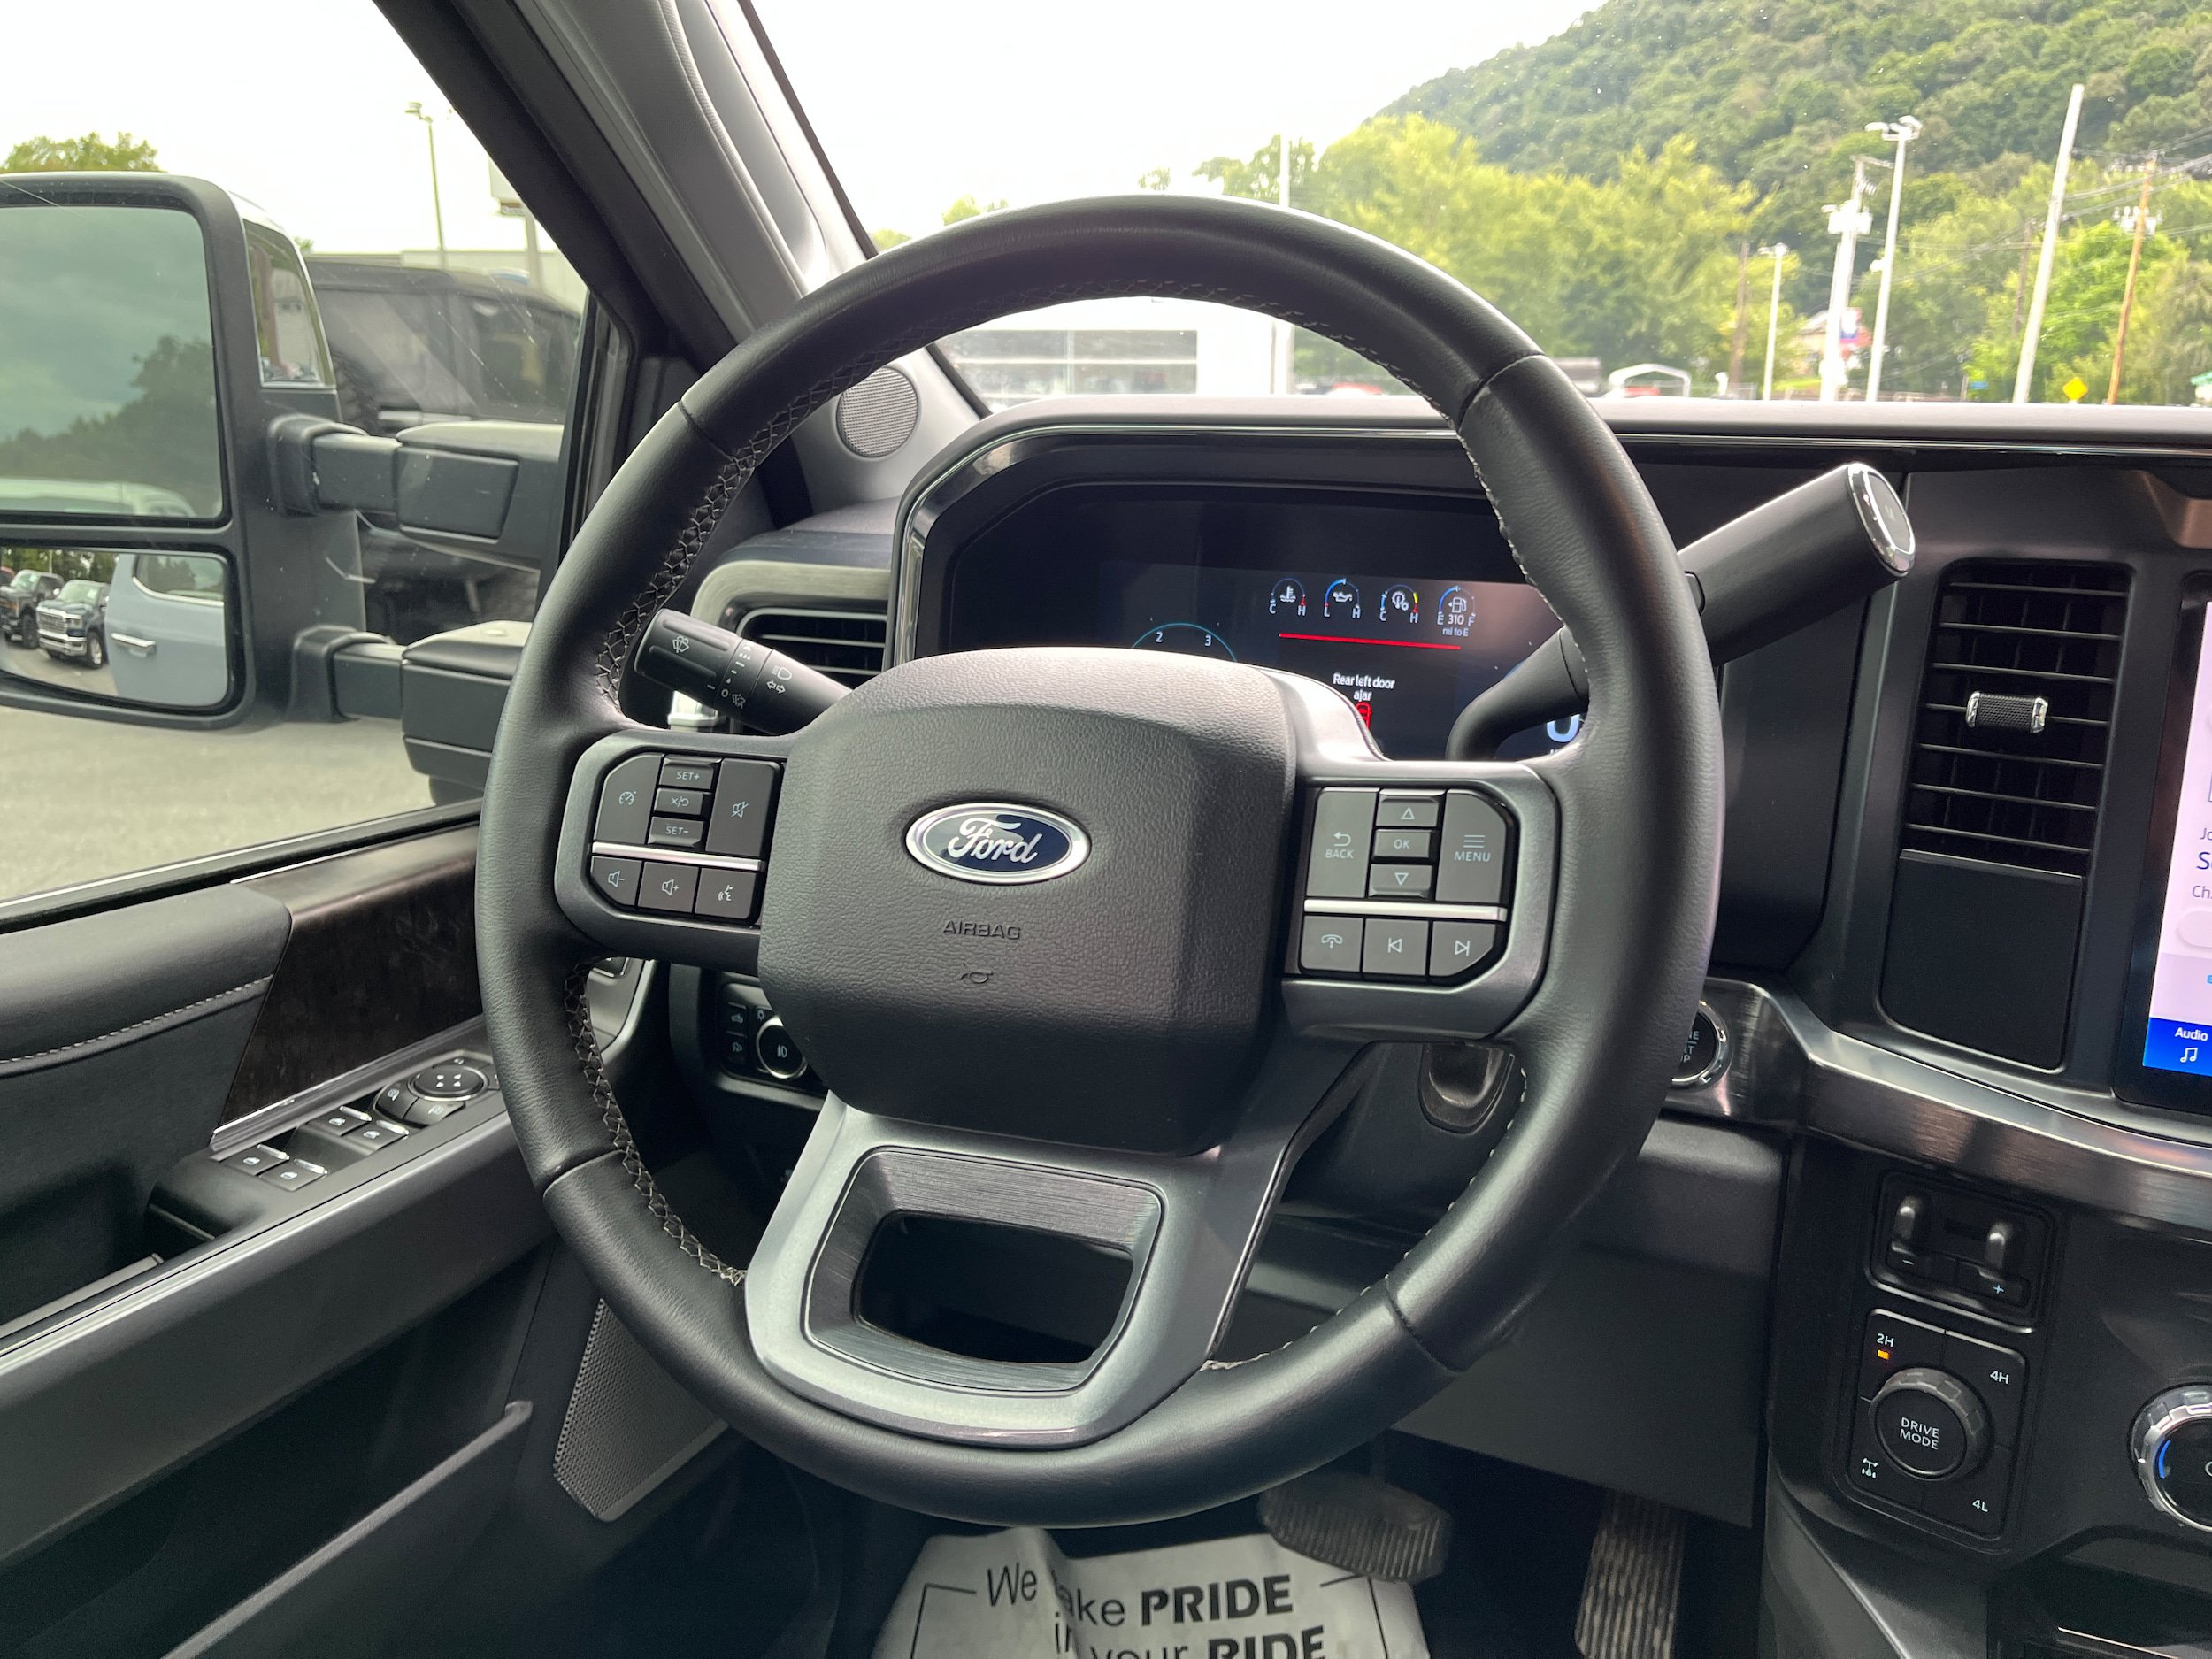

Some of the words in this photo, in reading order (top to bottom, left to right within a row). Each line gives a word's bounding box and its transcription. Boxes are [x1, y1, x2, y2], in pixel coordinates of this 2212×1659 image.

[1297, 605, 1306, 616] H
[1324, 606, 1331, 618] L
[1352, 608, 1361, 619] H
[1409, 612, 1419, 624] H
[1437, 614, 1445, 626] E
[1448, 614, 1465, 626] 310
[1468, 616, 1475, 627] F
[1156, 631, 1164, 643] 2
[1442, 627, 1453, 636] mi
[1454, 627, 1463, 636] to
[1463, 628, 1469, 637] E
[1204, 634, 1212, 647] 3
[1333, 672, 1355, 687] Rear
[1355, 674, 1371, 687] left
[1372, 676, 1395, 689] door
[1353, 688, 1372, 702] ajar
[676, 771, 701, 780] SET+
[947, 817, 1043, 864] Ford
[1394, 839, 1410, 849] OK
[1325, 849, 1354, 859] BACK
[1454, 851, 1491, 863] MENU
[943, 920, 1021, 940] AIRBAG
[2174, 1027, 2208, 1041] Audio
[1876, 1333, 1895, 1348] 2H
[1990, 1371, 2009, 1385] 4H
[1901, 1417, 1940, 1439] DRIVE
[1900, 1429, 1939, 1450] MODE
[1972, 1499, 1989, 1512] 4L
[987, 1562, 1037, 1607] We
[1051, 1570, 1125, 1626] ake
[1141, 1573, 1293, 1626] PRIDE
